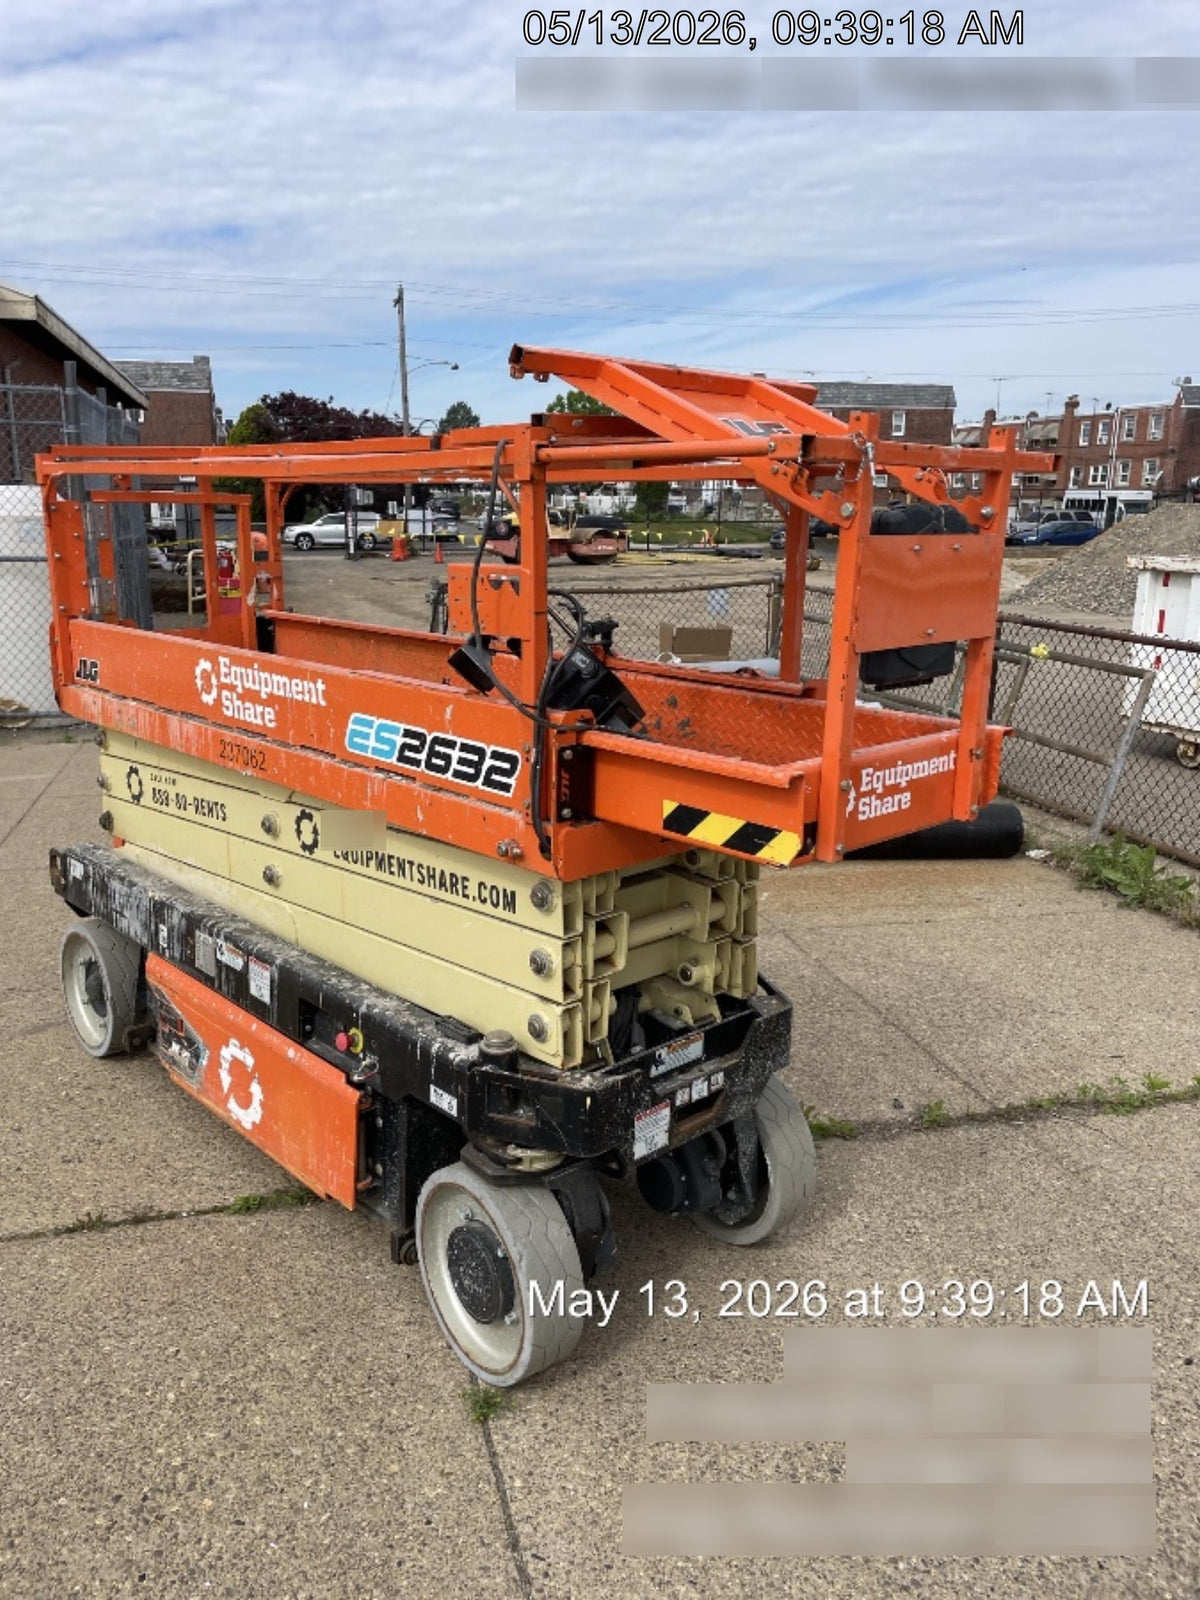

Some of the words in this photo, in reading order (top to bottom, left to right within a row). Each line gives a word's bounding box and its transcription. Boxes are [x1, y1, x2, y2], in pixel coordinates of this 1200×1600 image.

[76, 657, 99, 683] JLG
[218, 656, 326, 706] Equipment
[221, 692, 277, 727] Share
[219, 739, 267, 770] 237062
[346, 713, 520, 796] ES2632
[860, 750, 956, 793] Equipment
[858, 791, 911, 821] Share
